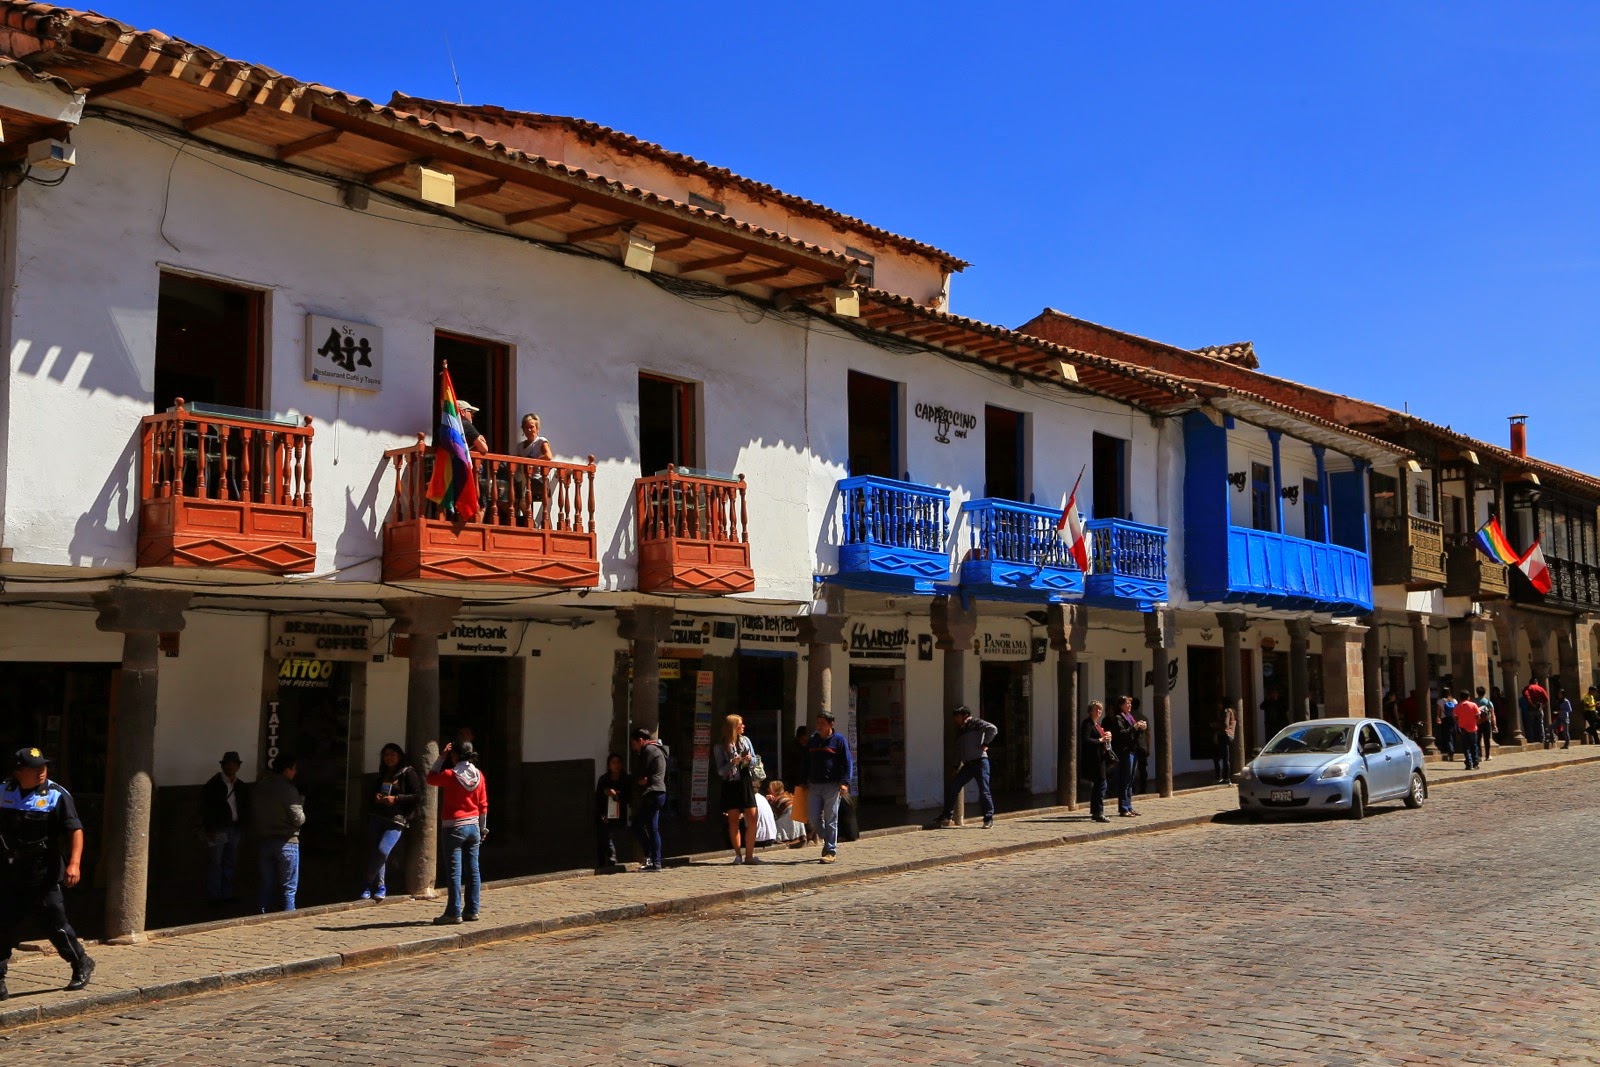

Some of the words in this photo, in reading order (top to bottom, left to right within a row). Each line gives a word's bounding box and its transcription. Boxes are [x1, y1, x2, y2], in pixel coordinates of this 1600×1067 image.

[342, 325, 356, 336] Sr.
[313, 368, 346, 379] Restaurant
[285, 620, 369, 637] RESTAURANT
[316, 637, 369, 650] COFFEE
[984, 633, 1027, 649] PANORAMA
[456, 642, 478, 653] Money
[478, 643, 508, 654] Exchange
